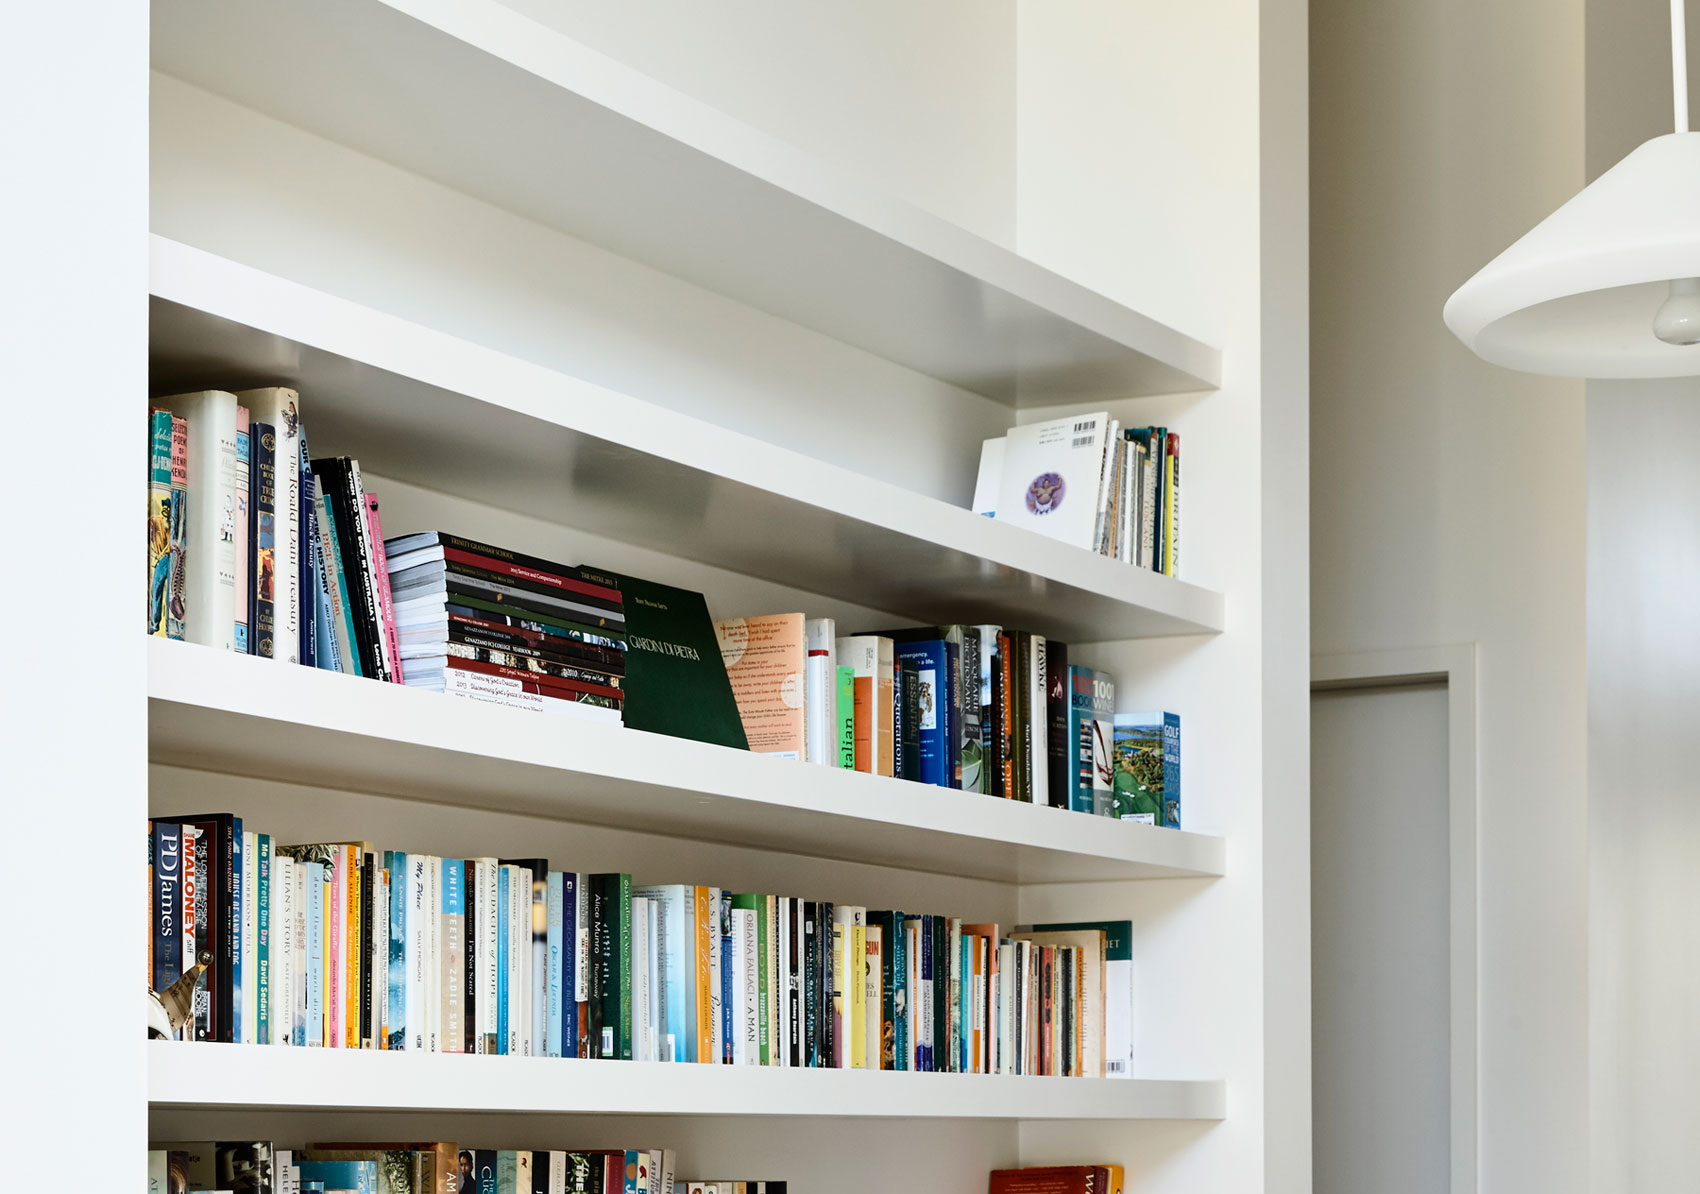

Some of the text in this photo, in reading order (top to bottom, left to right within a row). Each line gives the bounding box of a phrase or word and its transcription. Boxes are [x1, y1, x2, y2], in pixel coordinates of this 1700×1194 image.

[289, 453, 297, 474] The
[300, 439, 310, 464] OUR
[289, 477, 297, 522] Roald
[352, 498, 359, 512] DO
[354, 515, 362, 533] YOU
[357, 535, 366, 557] BOW
[451, 537, 514, 560] TRINITY GRAMMAR SCHOOL
[316, 546, 329, 595] HISTORY
[361, 560, 367, 568] IN
[590, 573, 604, 583] MITRE
[287, 573, 297, 636] Treasury
[329, 580, 341, 616] Action
[567, 668, 578, 678] 2010
[971, 638, 980, 712] MACQUARIE
[1038, 642, 1047, 691] HAWKE
[456, 681, 467, 690] 2013
[909, 676, 918, 740] ESSENTIAL
[894, 692, 903, 772] Quotations
[1164, 724, 1180, 737] GOLF
[841, 717, 853, 770] talian
[1164, 755, 1179, 764] WORLD
[195, 845, 201, 858] OF
[262, 844, 268, 857] Me
[416, 862, 423, 879] My
[159, 832, 178, 937] PD James
[184, 838, 195, 954] MALONEY stiff
[260, 880, 268, 907] Pretty
[449, 866, 457, 949] WHITE TEETH
[260, 929, 268, 946] Day
[489, 949, 496, 959] of
[747, 958, 755, 994] FALLACI
[449, 969, 457, 1051] ZADIE SMITH
[576, 1162, 585, 1191] THE
